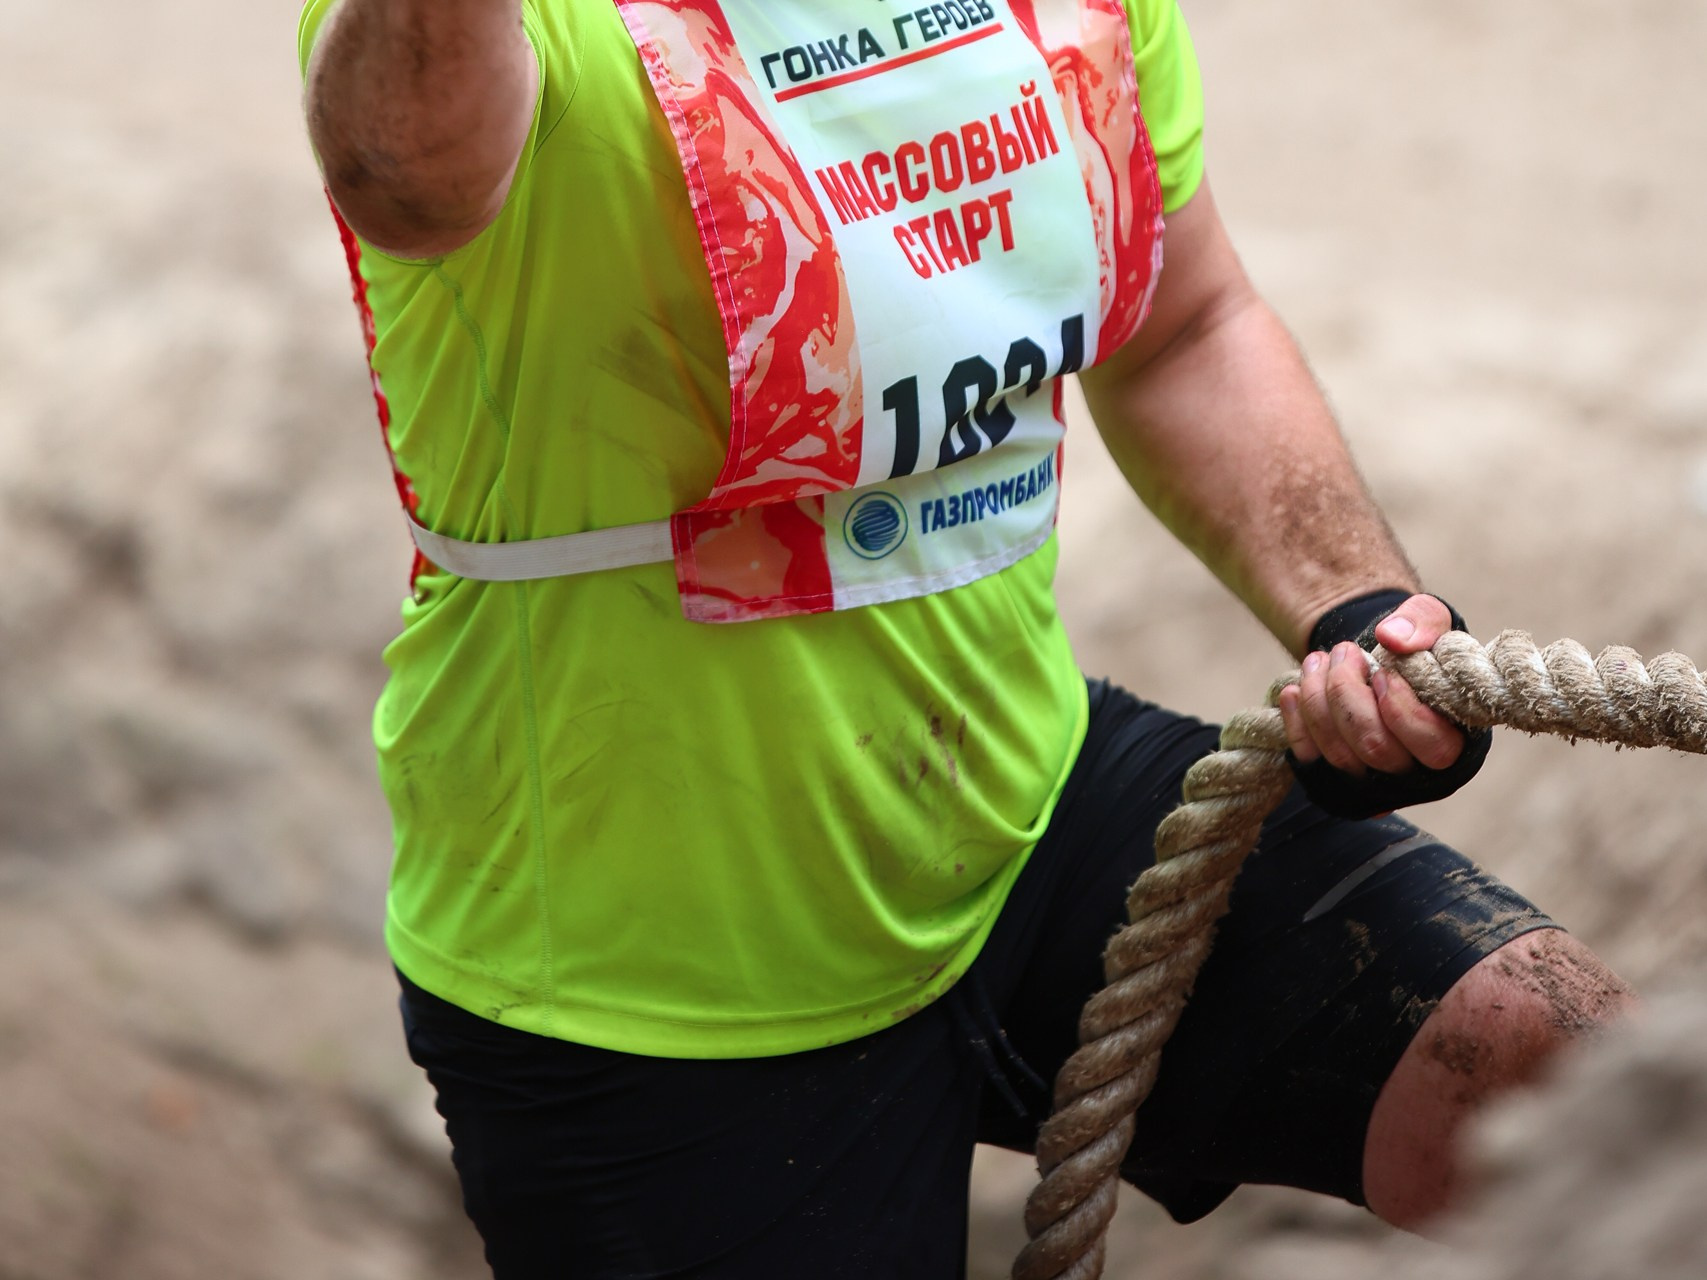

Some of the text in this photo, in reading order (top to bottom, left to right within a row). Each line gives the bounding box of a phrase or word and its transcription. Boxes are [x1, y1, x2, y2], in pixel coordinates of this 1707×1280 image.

[760, 27, 886, 89] ГОНКА
[814, 79, 1061, 226] МАССОВЫЙ
[893, 188, 1015, 280] СТАРТ
[920, 450, 1055, 535] ГАЗПРОМБАНК
